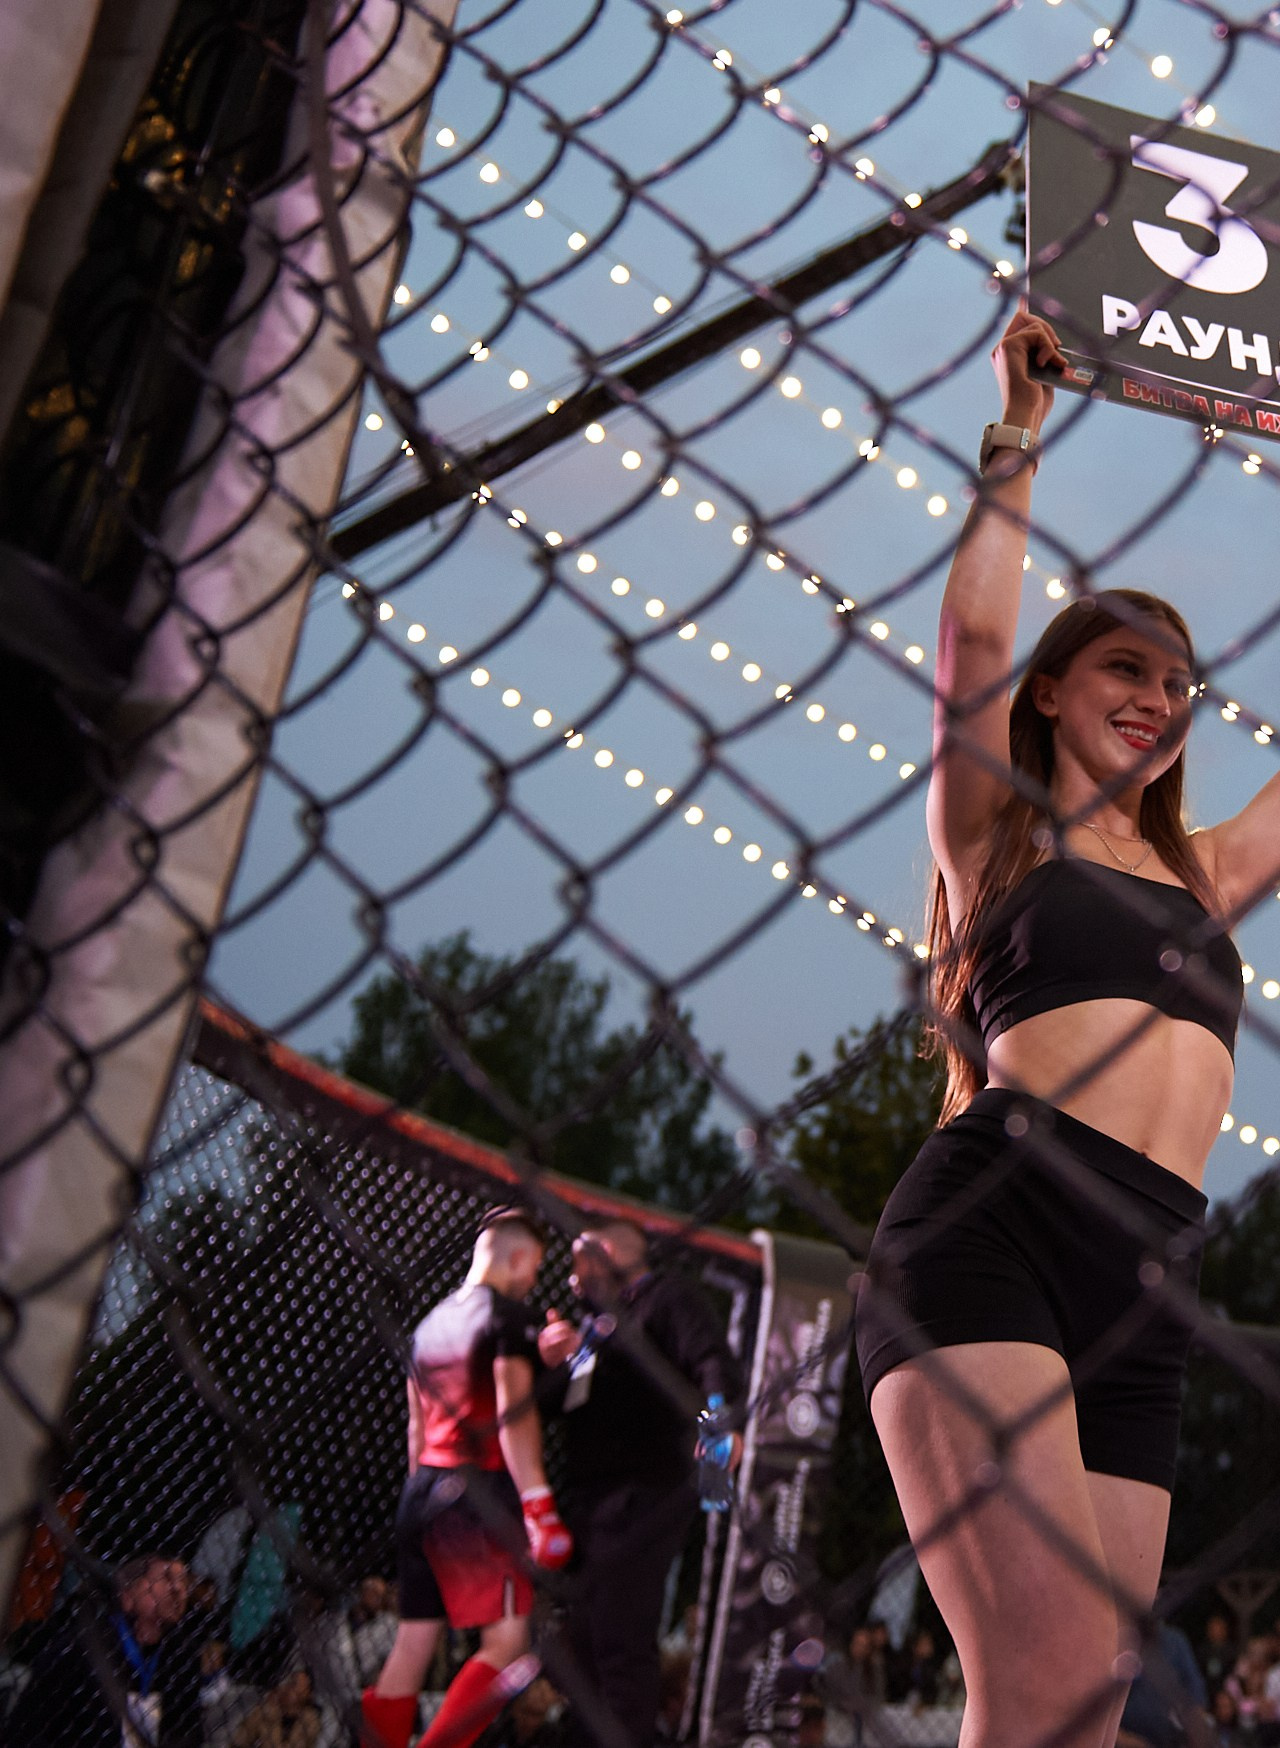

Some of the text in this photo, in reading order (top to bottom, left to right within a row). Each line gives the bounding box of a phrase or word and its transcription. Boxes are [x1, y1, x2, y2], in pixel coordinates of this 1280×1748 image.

[1130, 134, 1268, 294] 3
[1122, 378, 1211, 416] БИТВА
[1214, 400, 1253, 427] НА
